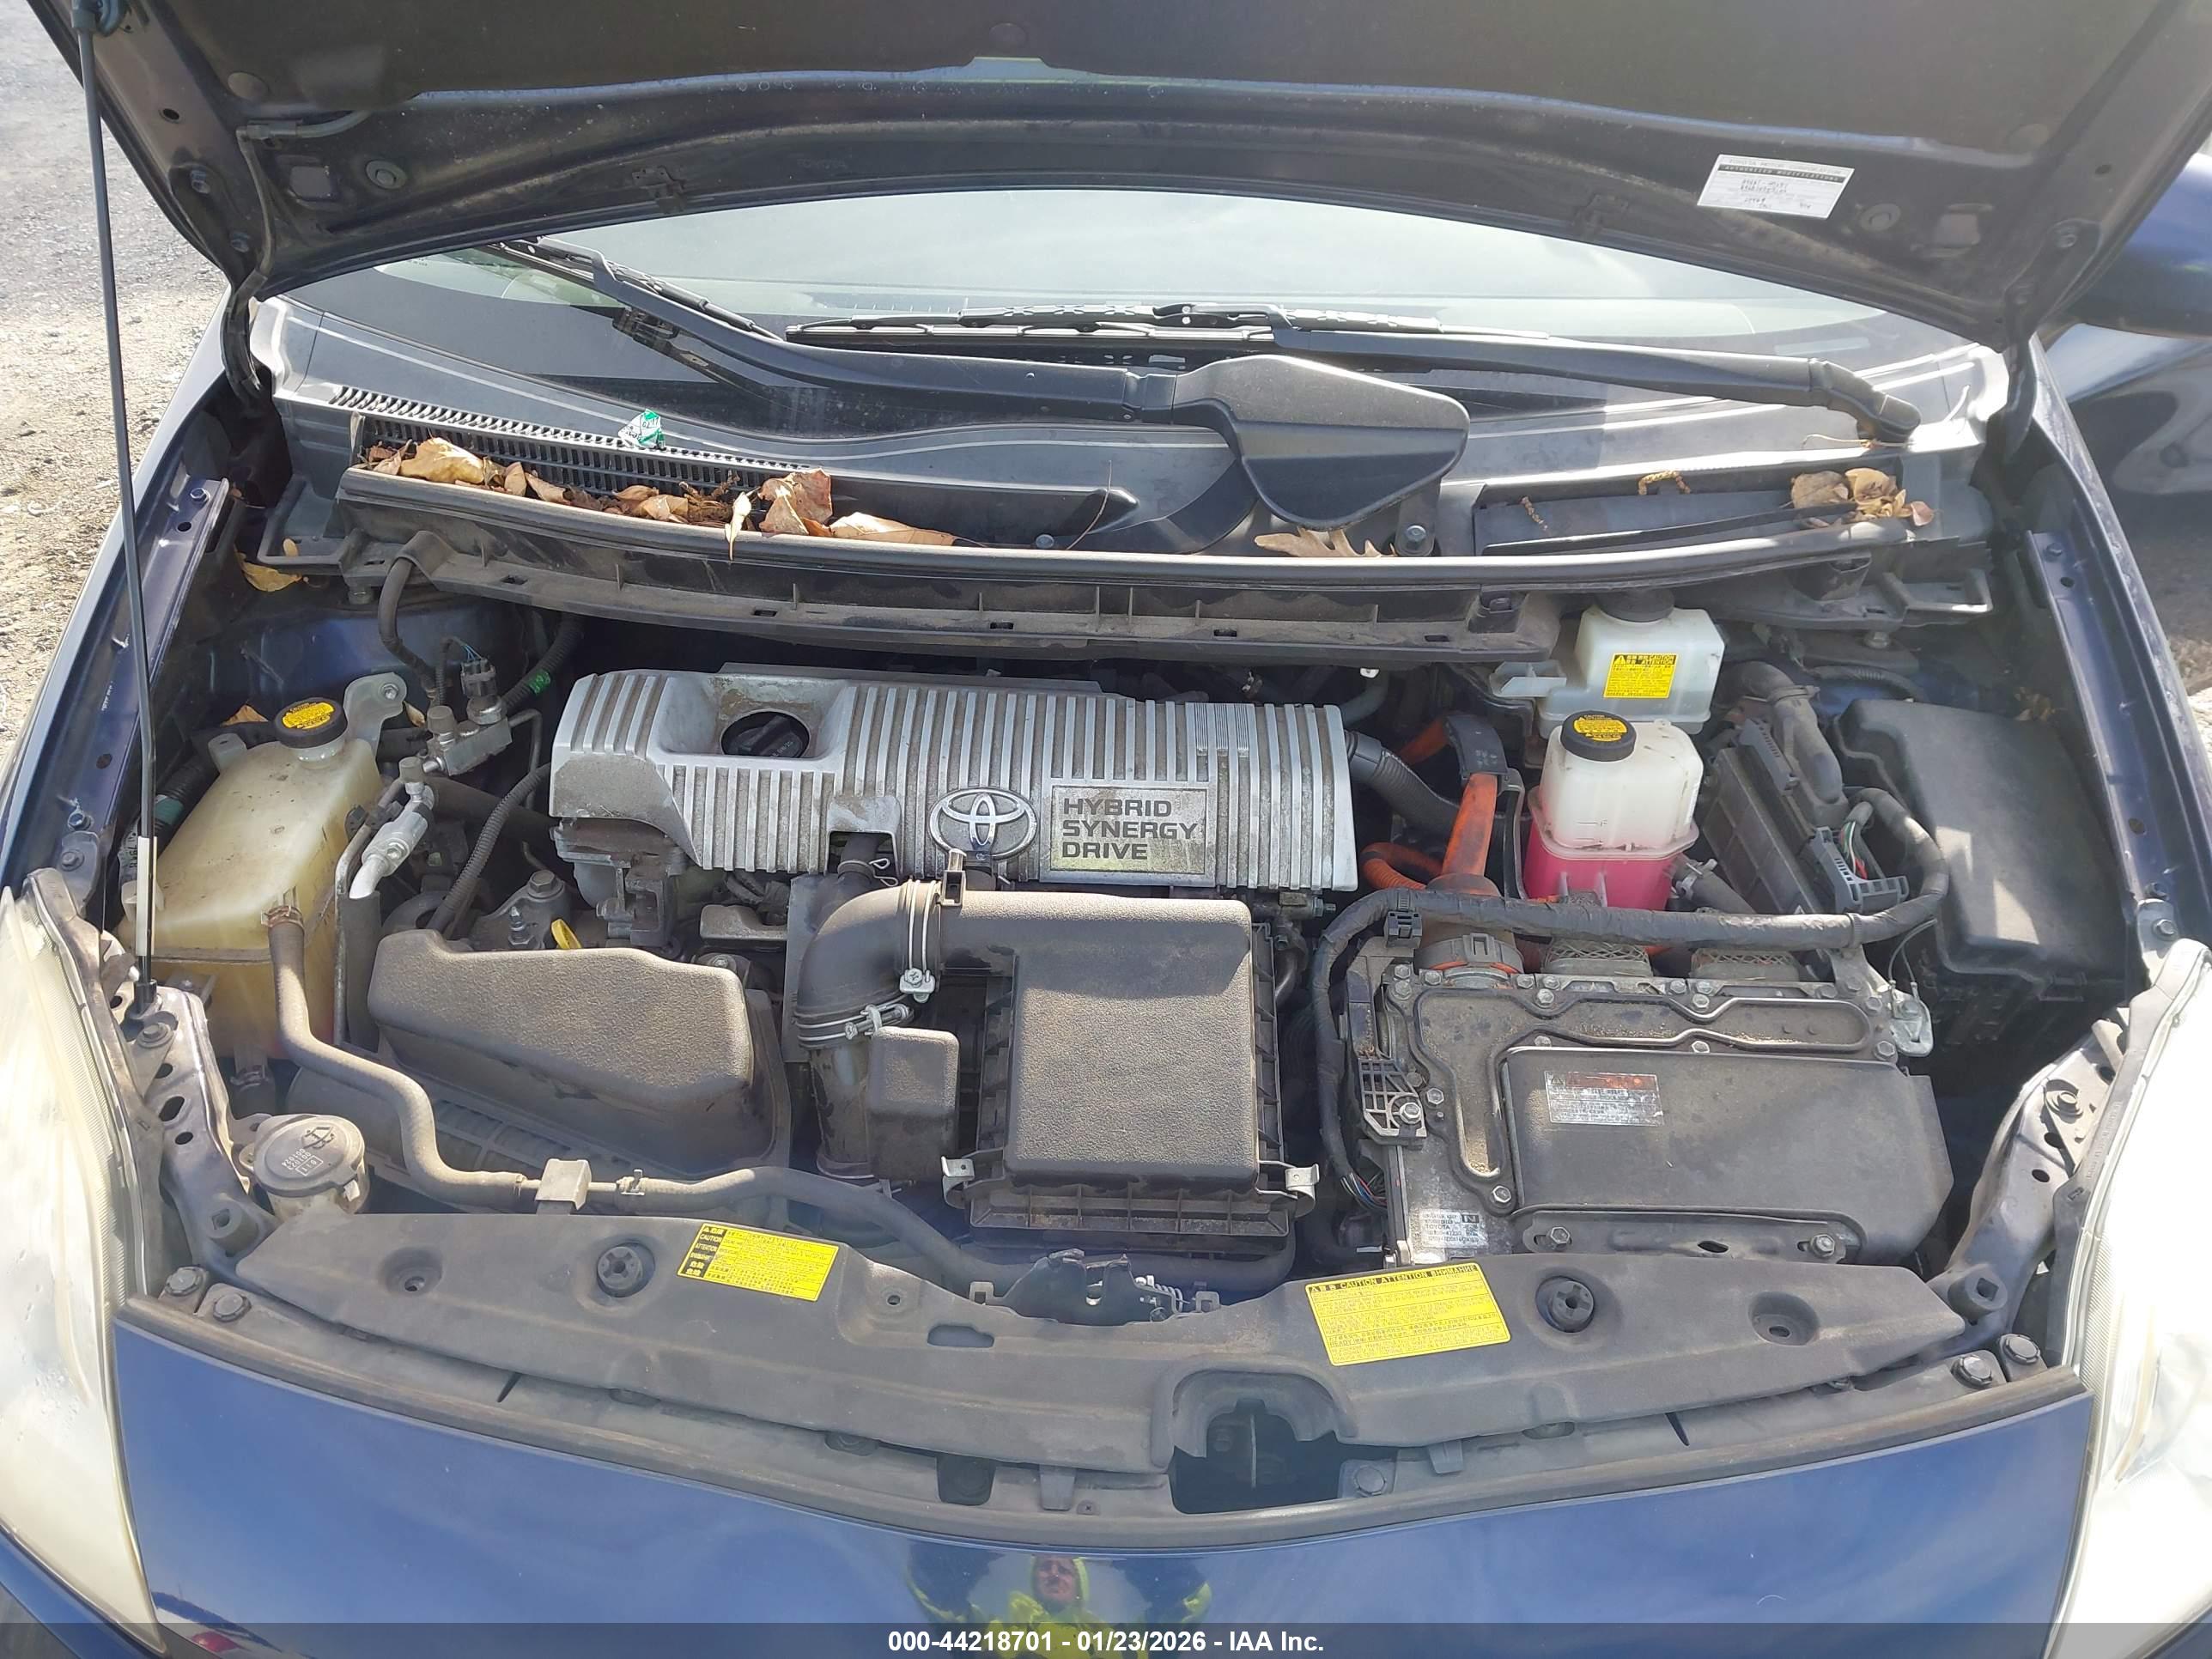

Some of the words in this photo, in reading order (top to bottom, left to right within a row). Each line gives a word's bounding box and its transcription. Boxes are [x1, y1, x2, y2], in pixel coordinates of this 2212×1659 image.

[1064, 798, 1172, 817] HYBRID
[1062, 819, 1199, 840] SYNERGY
[1062, 842, 1149, 860] DRIVE
[699, 1233, 722, 1243] CAUTION
[695, 1243, 718, 1252] ATTENTION
[1340, 1277, 1377, 1289] CAUTION
[1381, 1270, 1427, 1285] ATTENTION
